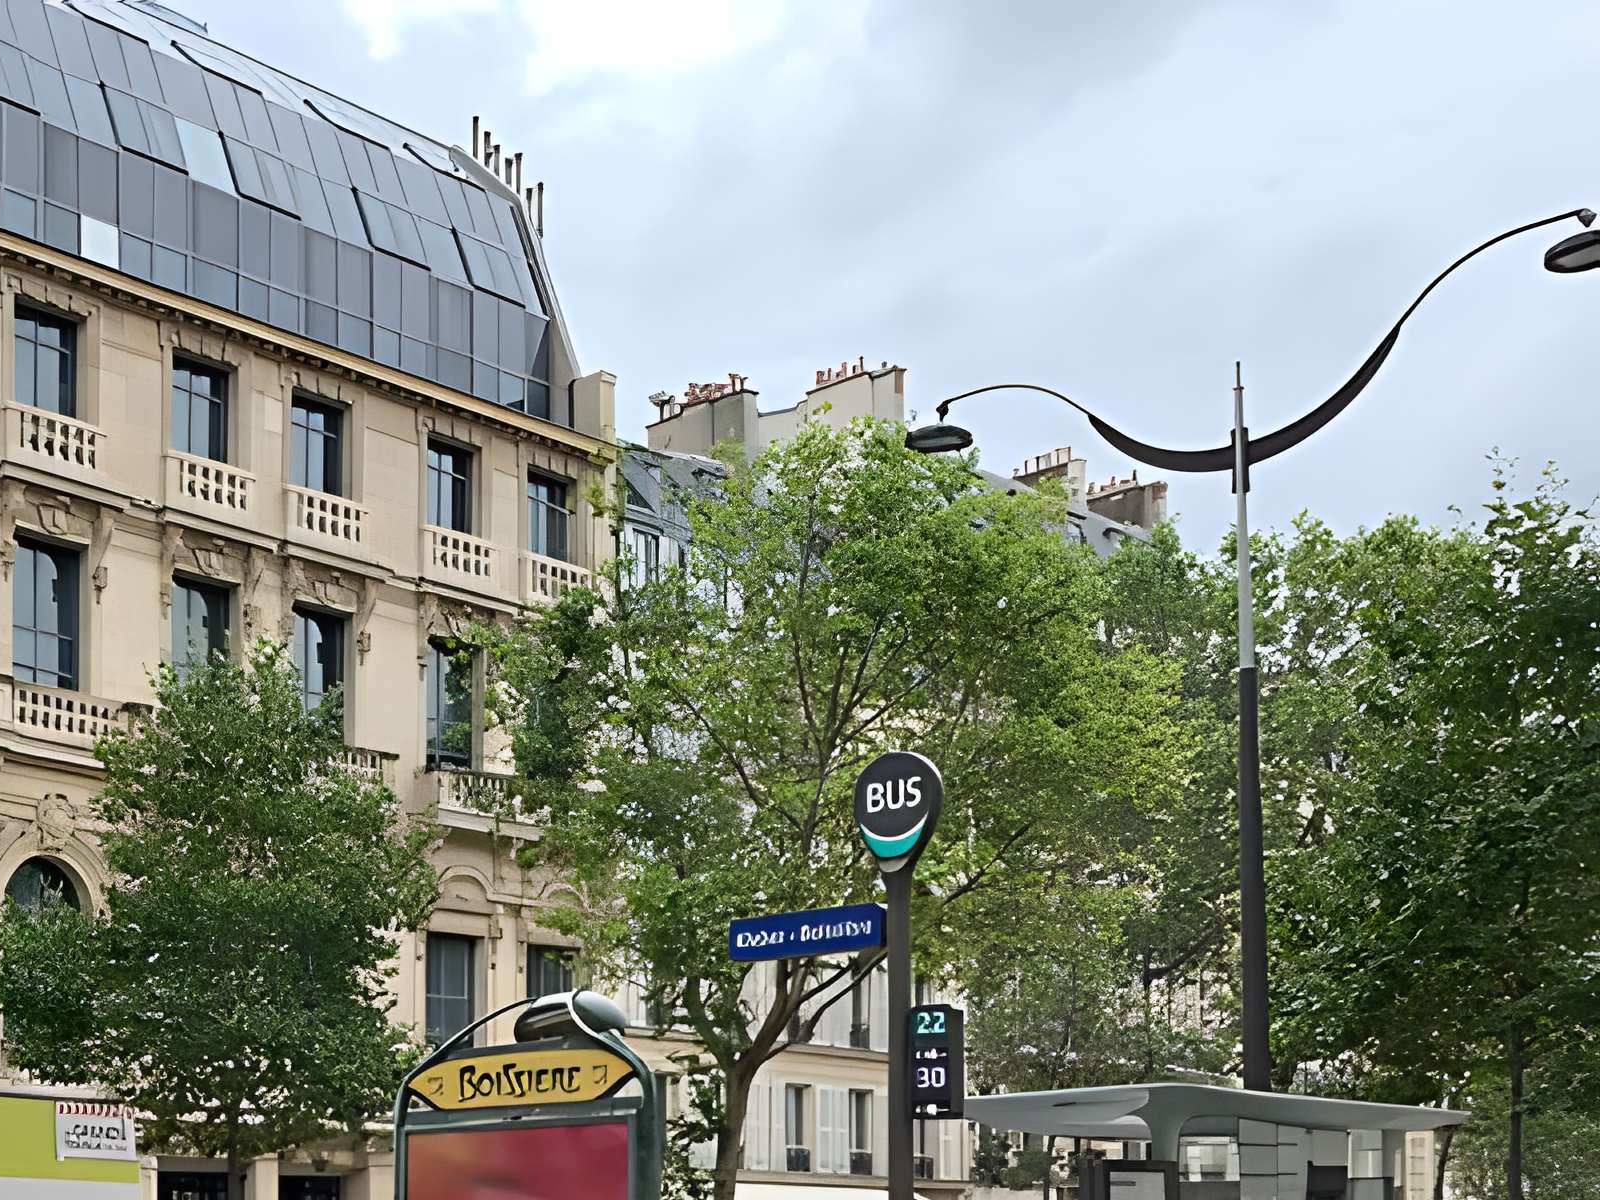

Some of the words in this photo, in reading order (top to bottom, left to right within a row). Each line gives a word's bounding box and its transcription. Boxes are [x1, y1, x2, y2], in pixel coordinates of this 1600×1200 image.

[866, 776, 922, 813] BUS
[916, 1011, 946, 1034] 22
[916, 1066, 946, 1088] 30
